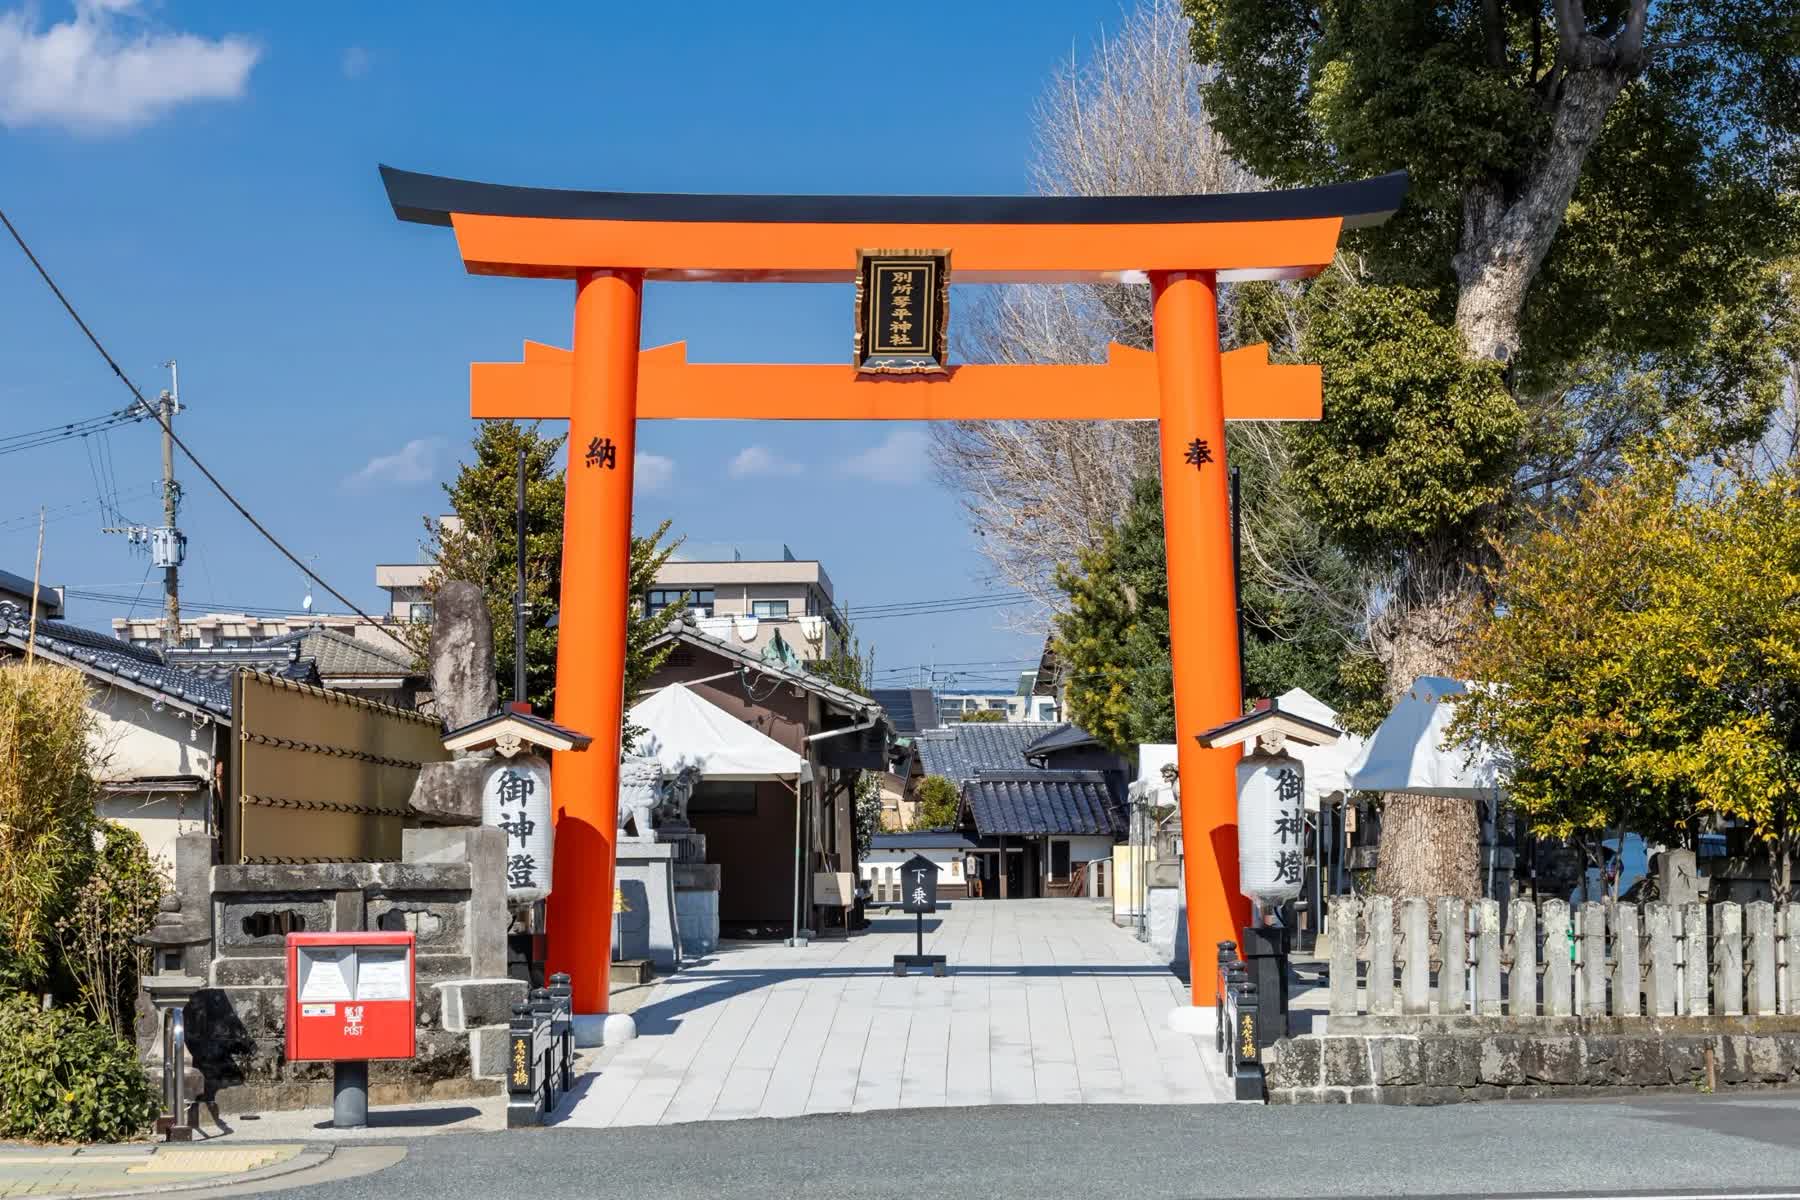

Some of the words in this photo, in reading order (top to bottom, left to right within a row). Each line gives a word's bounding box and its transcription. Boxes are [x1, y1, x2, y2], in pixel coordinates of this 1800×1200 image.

[889, 271, 913, 346] 別所琴平神社
[585, 436, 616, 470] 納
[1184, 437, 1214, 472] 奉
[1272, 767, 1303, 885] 御神燈
[911, 868, 928, 905] 下乗
[344, 1026, 364, 1036] POST
